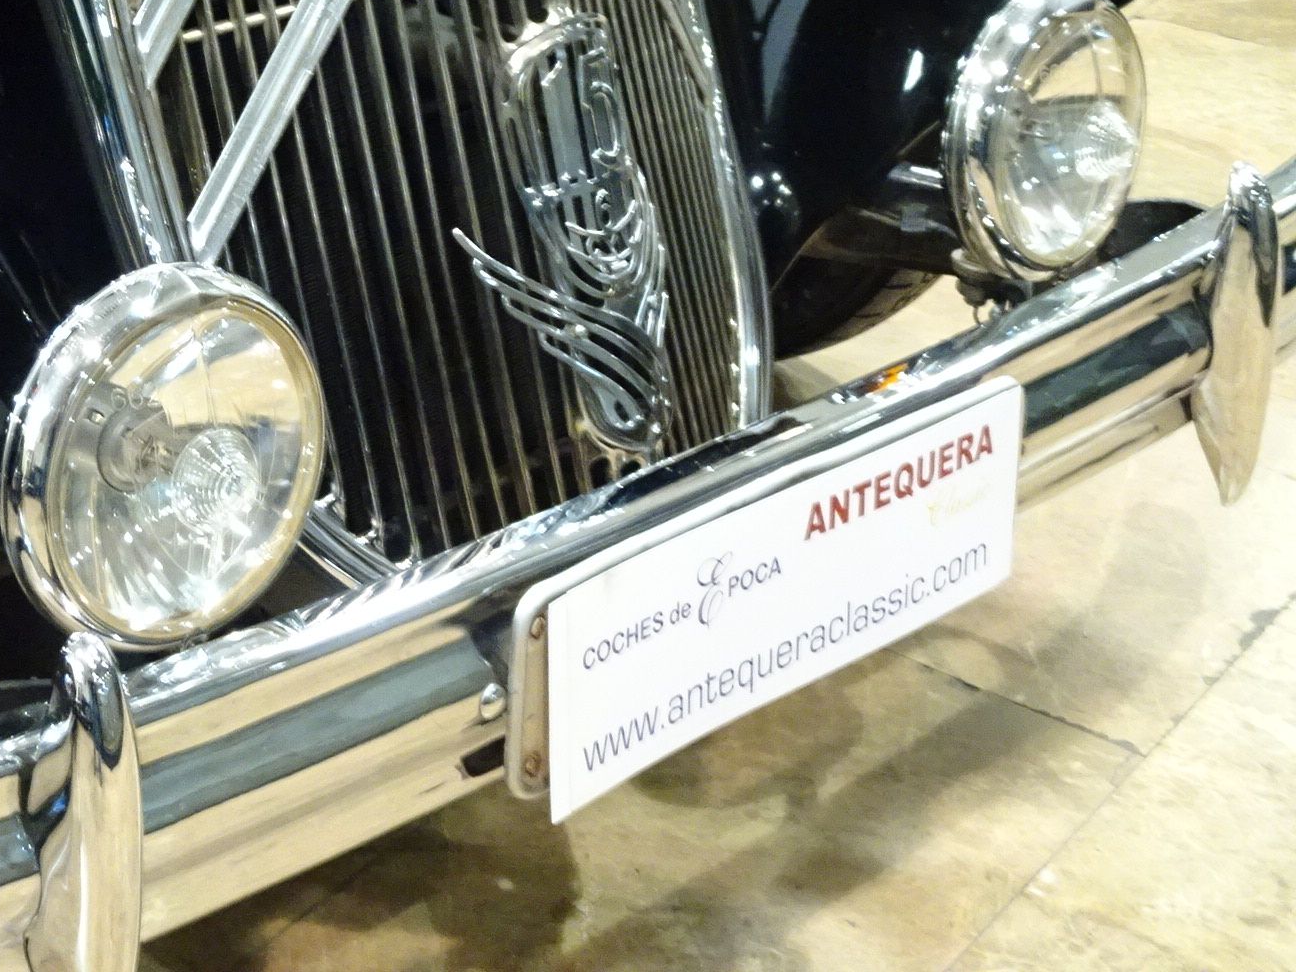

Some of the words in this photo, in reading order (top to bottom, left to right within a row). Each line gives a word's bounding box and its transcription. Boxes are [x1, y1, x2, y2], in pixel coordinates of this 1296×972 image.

[581, 610, 665, 672] COCHES
[669, 601, 692, 628] de
[803, 423, 995, 541] ANTEQUERA
[582, 540, 989, 774] www.antequeraclassic.com
